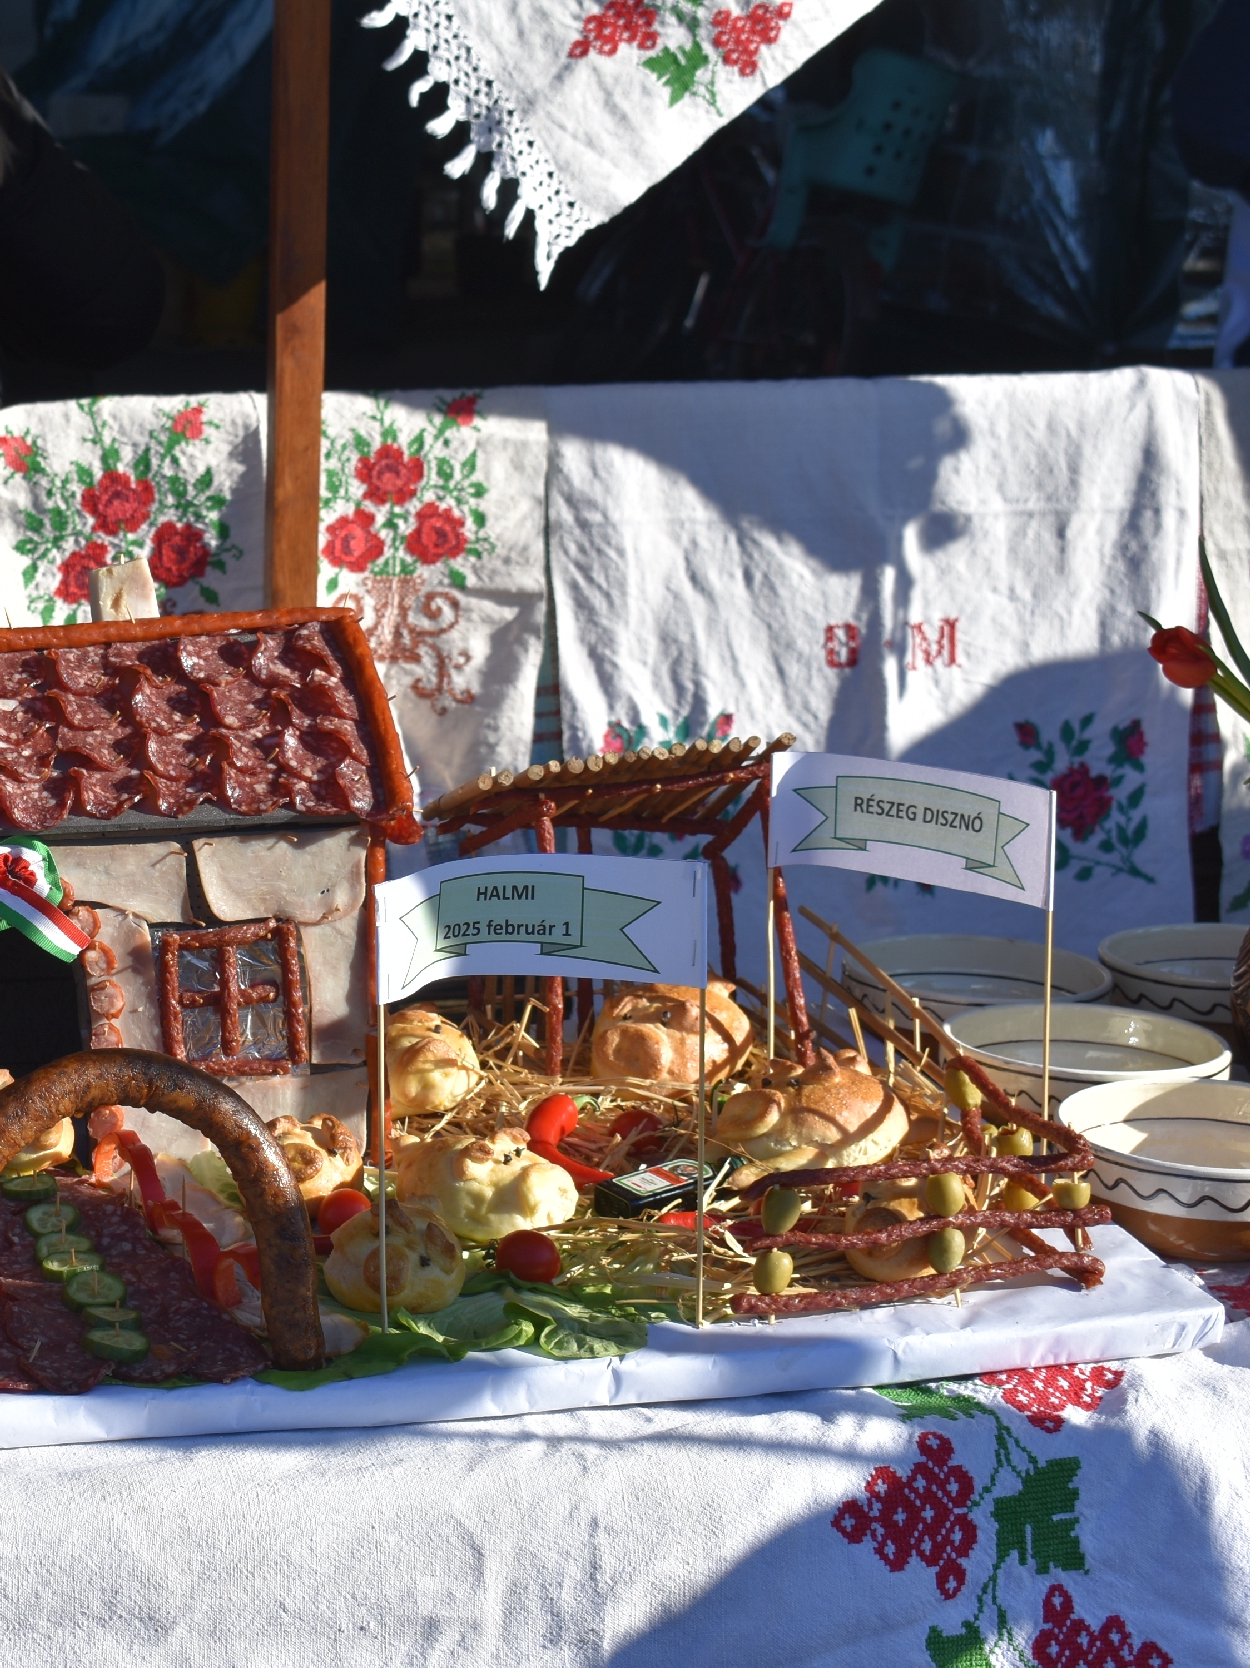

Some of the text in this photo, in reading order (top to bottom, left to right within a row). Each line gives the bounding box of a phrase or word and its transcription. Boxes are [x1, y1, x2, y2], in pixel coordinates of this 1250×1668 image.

[853, 794, 983, 833] RÉSZEG DISZNÓ
[476, 885, 535, 901] HALMI
[443, 919, 572, 940] 2025 február 1
